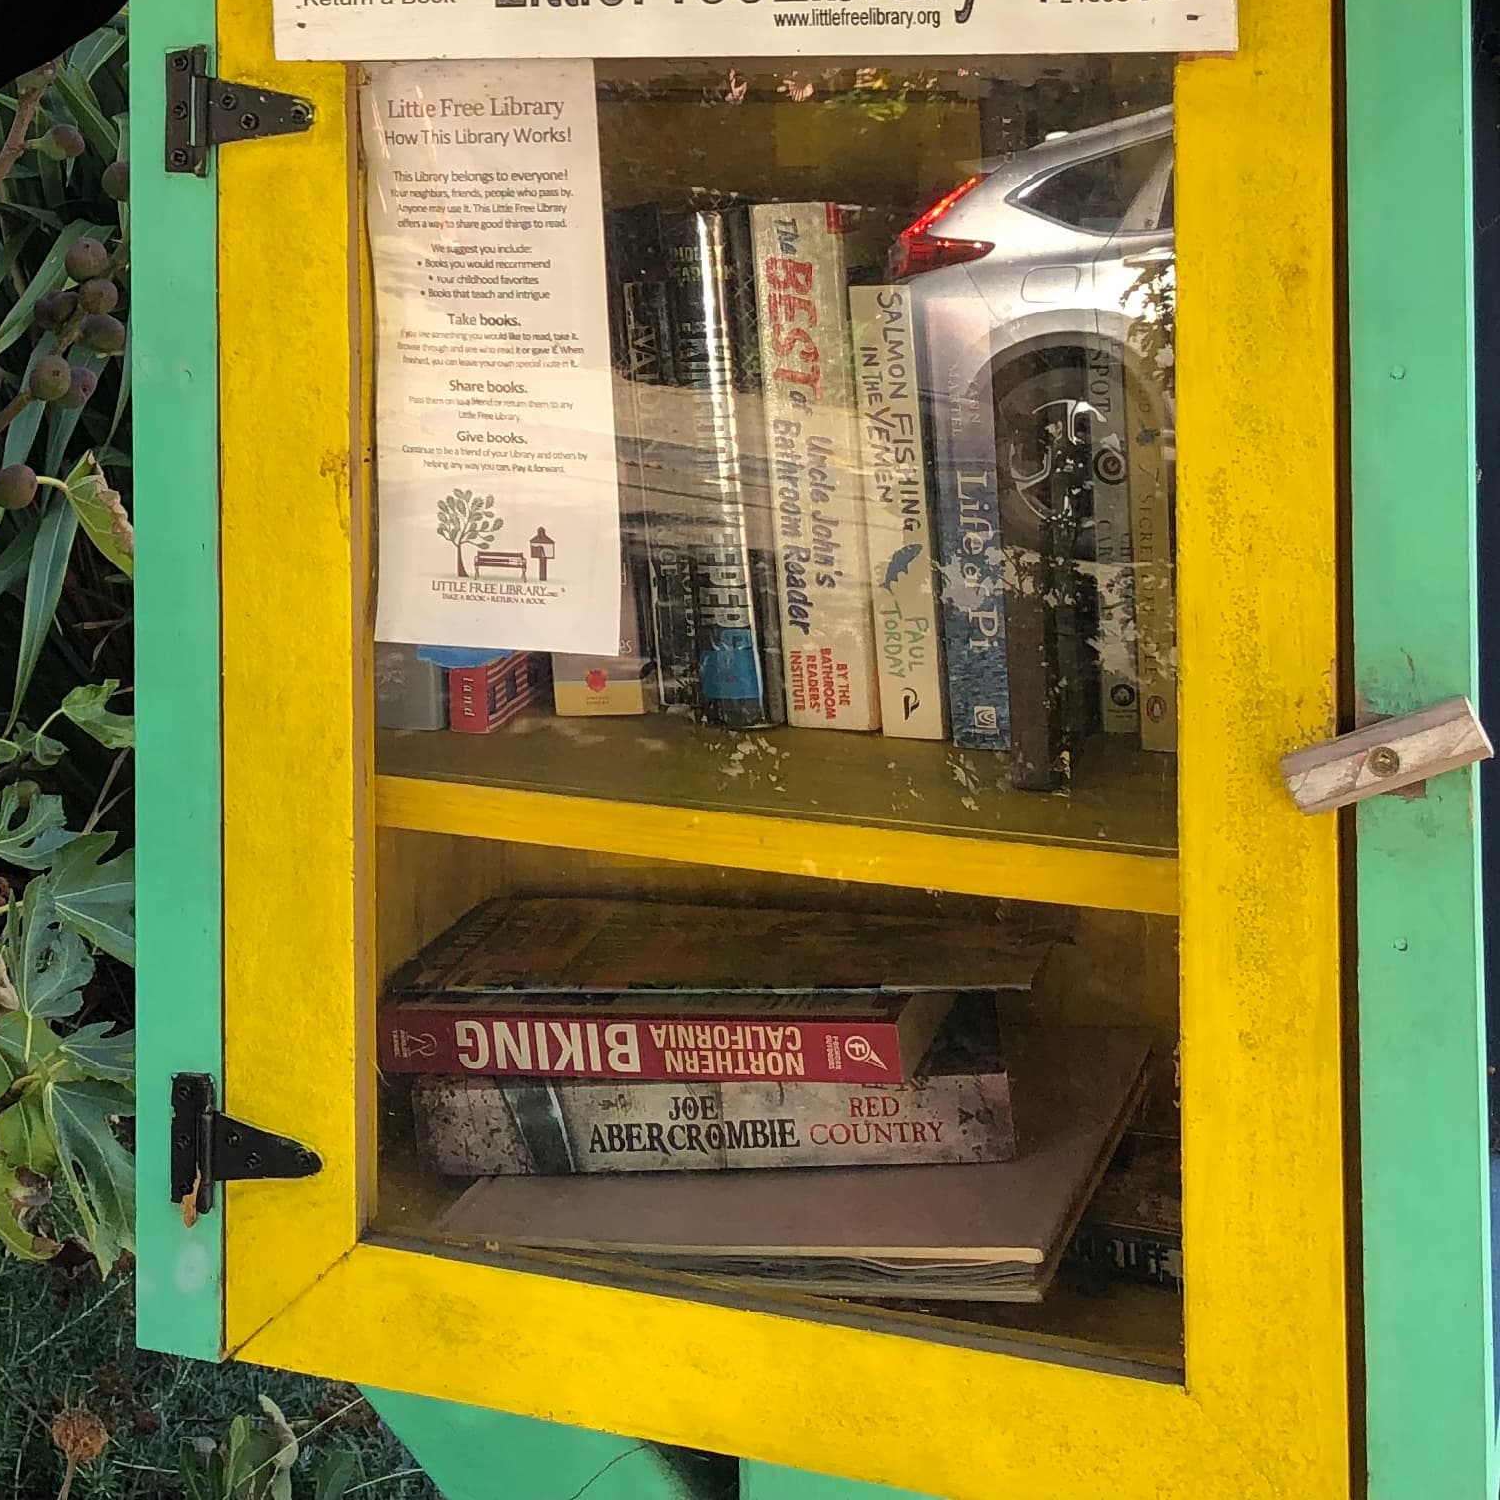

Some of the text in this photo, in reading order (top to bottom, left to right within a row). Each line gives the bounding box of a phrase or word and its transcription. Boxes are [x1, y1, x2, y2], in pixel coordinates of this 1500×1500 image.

[773, 6, 941, 29] www.littlefreelibrary.org
[387, 96, 565, 120] Little Free Library
[385, 126, 572, 147] How This Library Works!
[393, 168, 568, 185] This Library belongs to everyone!
[485, 187, 515, 200] people
[516, 187, 537, 197] who
[561, 187, 574, 198] by.
[397, 204, 427, 214] Anyone
[429, 205, 445, 213] may
[473, 203, 491, 212] This
[492, 203, 513, 213] Little
[515, 203, 535, 213] Free
[537, 203, 567, 214] Library
[398, 218, 567, 231] offers way to share good things to read.
[431, 243, 445, 253] We
[446, 245, 478, 255] suggest
[479, 246, 496, 255] you
[425, 258, 551, 270] Books you would recommend
[437, 274, 539, 285] Your childhood favorites
[428, 288, 550, 301] Books that teach and intrigue
[446, 312, 521, 327] Take books.
[765, 218, 823, 416] The BEST of
[484, 332, 569, 342] would like to read, take
[531, 345, 584, 356] gave When
[432, 359, 444, 368] you
[479, 360, 496, 369] your
[515, 359, 541, 369] special
[448, 378, 528, 394] Share books.
[1089, 349, 1111, 414] SPOT
[425, 396, 444, 405] them
[471, 396, 493, 406] friend
[528, 400, 549, 408] them
[559, 402, 573, 411] any
[877, 291, 922, 532] SALMON FISHING
[458, 410, 493, 420] Little Free
[860, 346, 897, 504] IN THE YEMEN
[456, 430, 528, 445] Give books.
[402, 444, 435, 454] Continue
[460, 446, 481, 457] friend
[491, 450, 508, 459] your
[509, 449, 535, 460] Library
[536, 451, 551, 459] and
[578, 451, 588, 461] by
[423, 459, 449, 470] helping
[450, 461, 463, 471] any
[480, 463, 495, 472] you
[512, 463, 526, 474] Pay
[806, 435, 843, 589] Uncle John's
[773, 418, 813, 636] Bathroom Reader
[956, 470, 999, 650] Life of Pi
[431, 579, 497, 595] LITTLE FREE
[442, 592, 546, 605] TAKE BOOK RETURN BOOK
[880, 600, 906, 678] TORDAY
[905, 616, 929, 672] PAUL
[790, 650, 806, 711] INSTITUTE
[820, 647, 836, 720] BATHROOM
[837, 663, 850, 706] BY THE
[454, 1020, 642, 1073] BIKING
[649, 1023, 802, 1051] CALIFORNIA
[665, 1050, 805, 1076] NORTHERN
[669, 1095, 718, 1121] JOE
[850, 1097, 899, 1118] RED
[588, 1118, 801, 1157] ABERCROMBIE
[810, 1121, 944, 1146] COUNTRY
